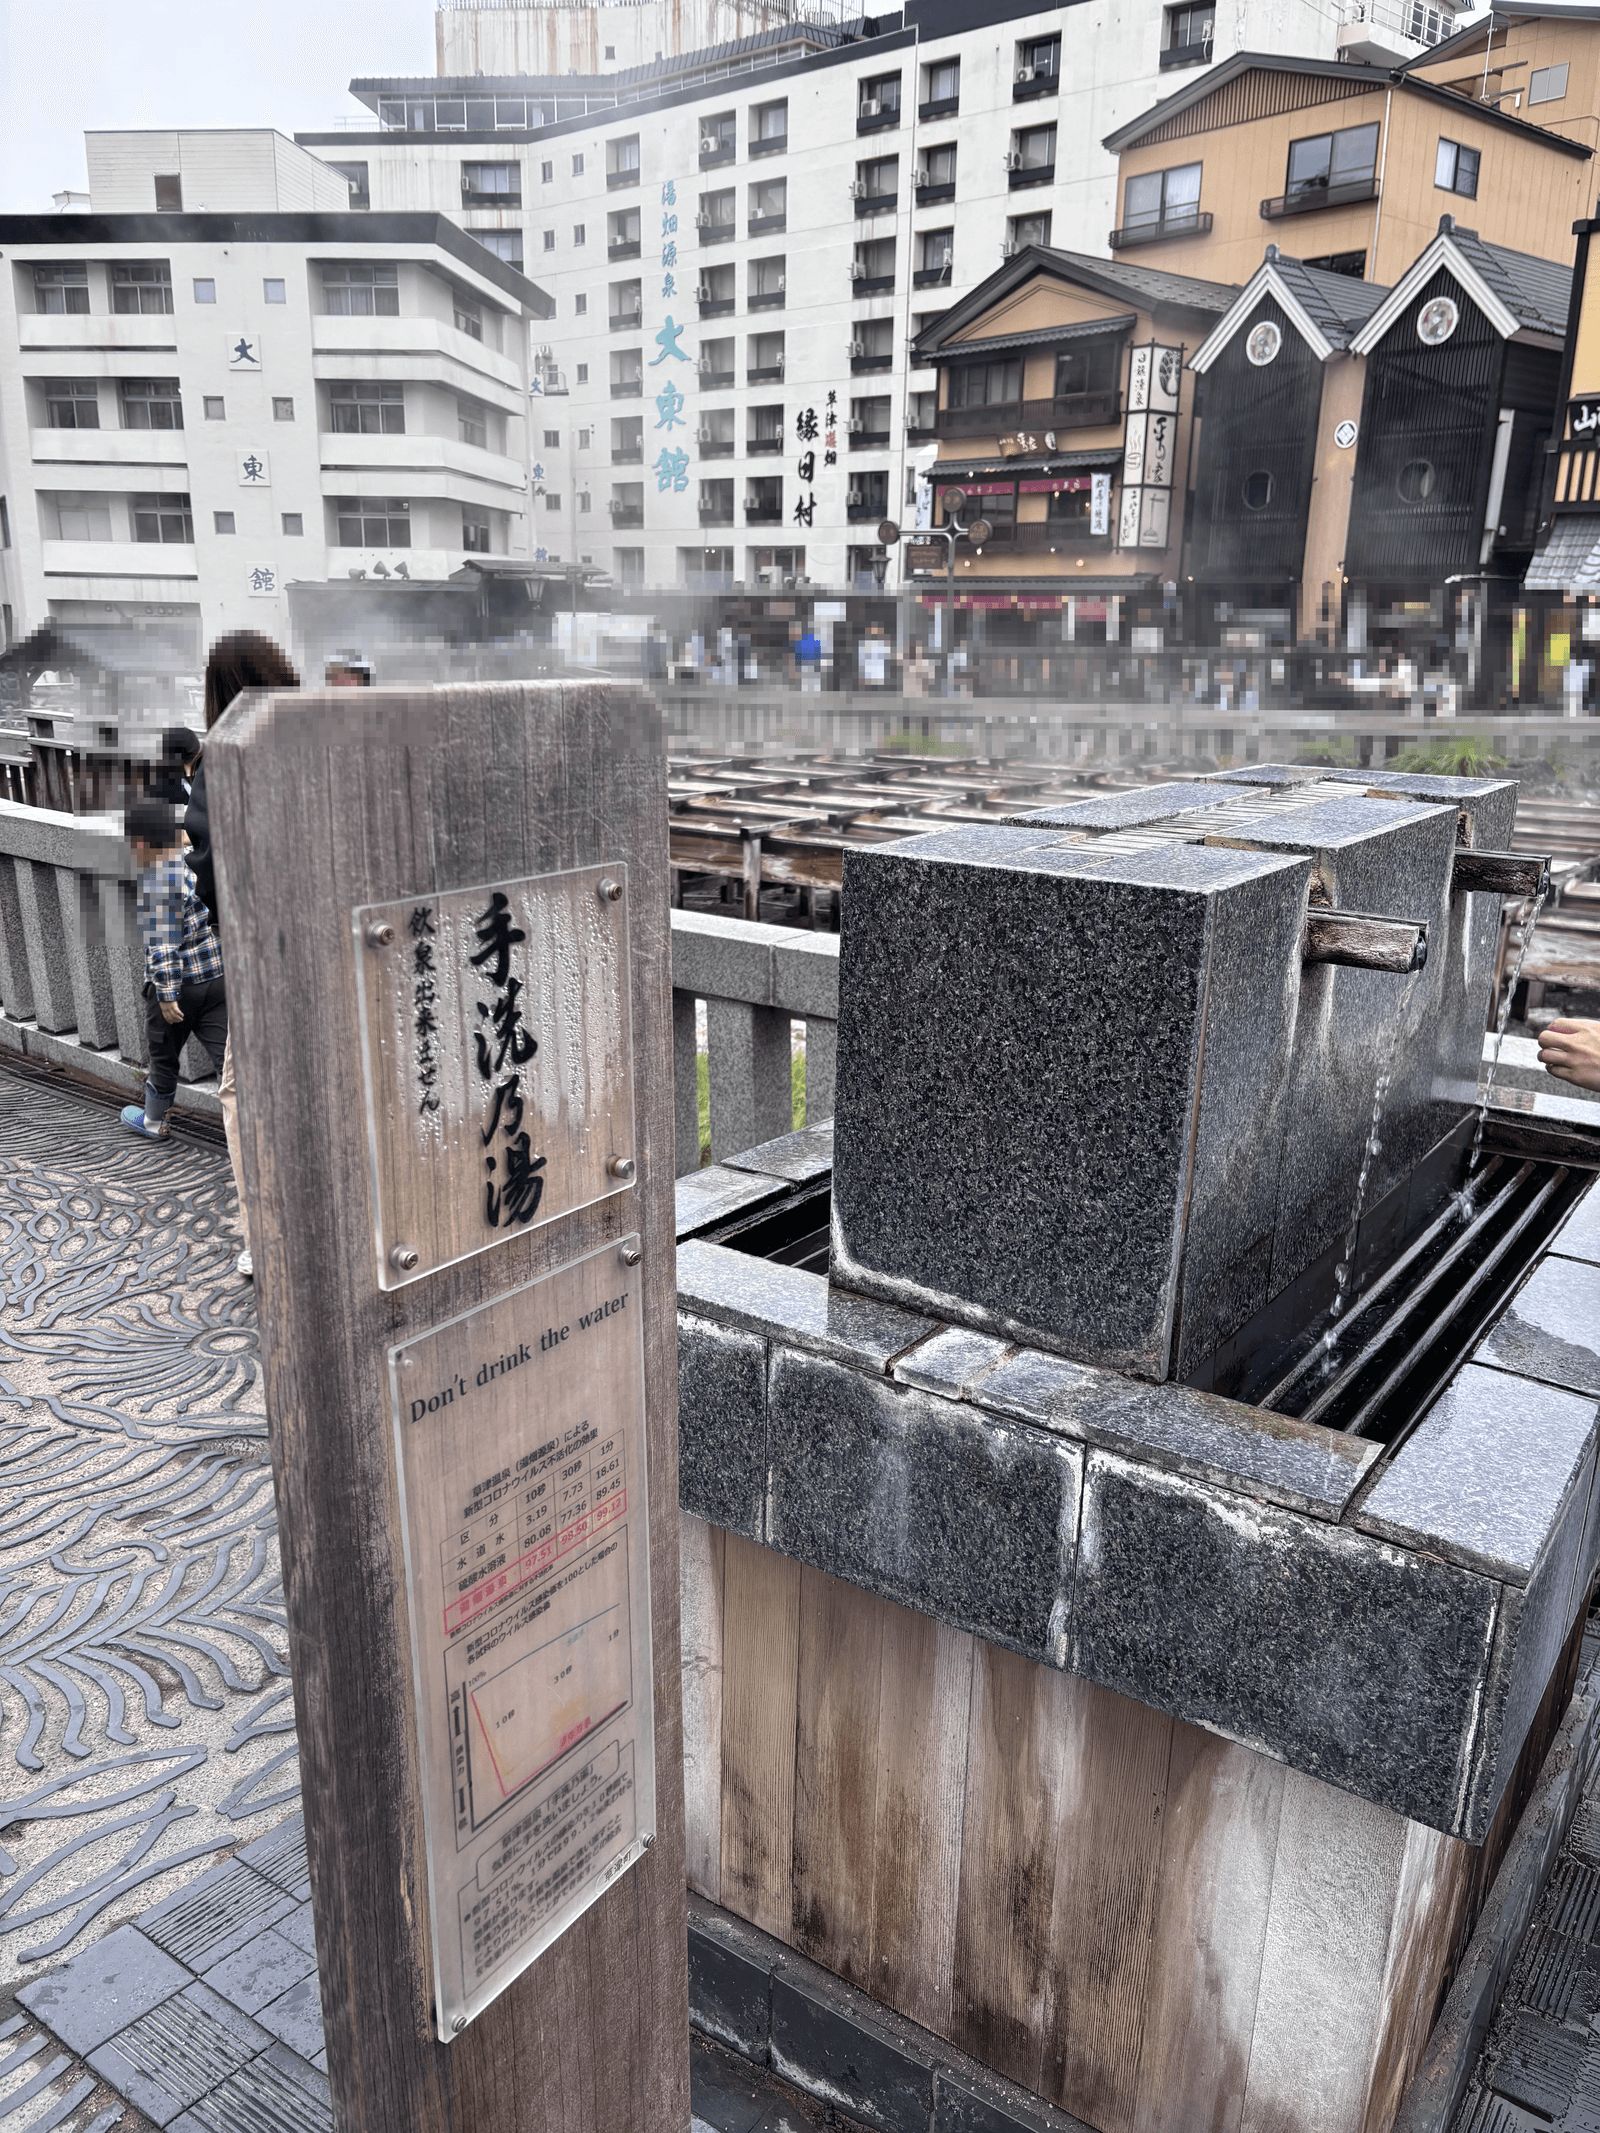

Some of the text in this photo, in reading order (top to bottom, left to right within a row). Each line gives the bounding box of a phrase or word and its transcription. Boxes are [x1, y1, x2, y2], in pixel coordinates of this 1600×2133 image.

[648, 315, 691, 492] 大東館
[230, 337, 274, 592] 大東館
[408, 906, 440, 1116] 飲泉出来ません
[469, 892, 548, 1229] 手洗乃湯
[410, 1291, 630, 1425] Don't drink the water
[464, 1426, 598, 1519] 新型コロナウイルス不活化の効果
[525, 1482, 545, 1504] 10秒
[562, 1458, 582, 1481] 30秒
[600, 1438, 613, 1456] 1分
[526, 1503, 547, 1526] 3.19
[562, 1480, 582, 1502] 7.73
[595, 1456, 619, 1480] 18.61
[458, 1476, 620, 1593] 硫酸水溶液 80.08 77.36 89.45
[525, 1544, 551, 1570] 97.51
[561, 1519, 587, 1545] 98.50
[596, 1496, 621, 1522] 99.12
[468, 1667, 486, 1687] 100%
